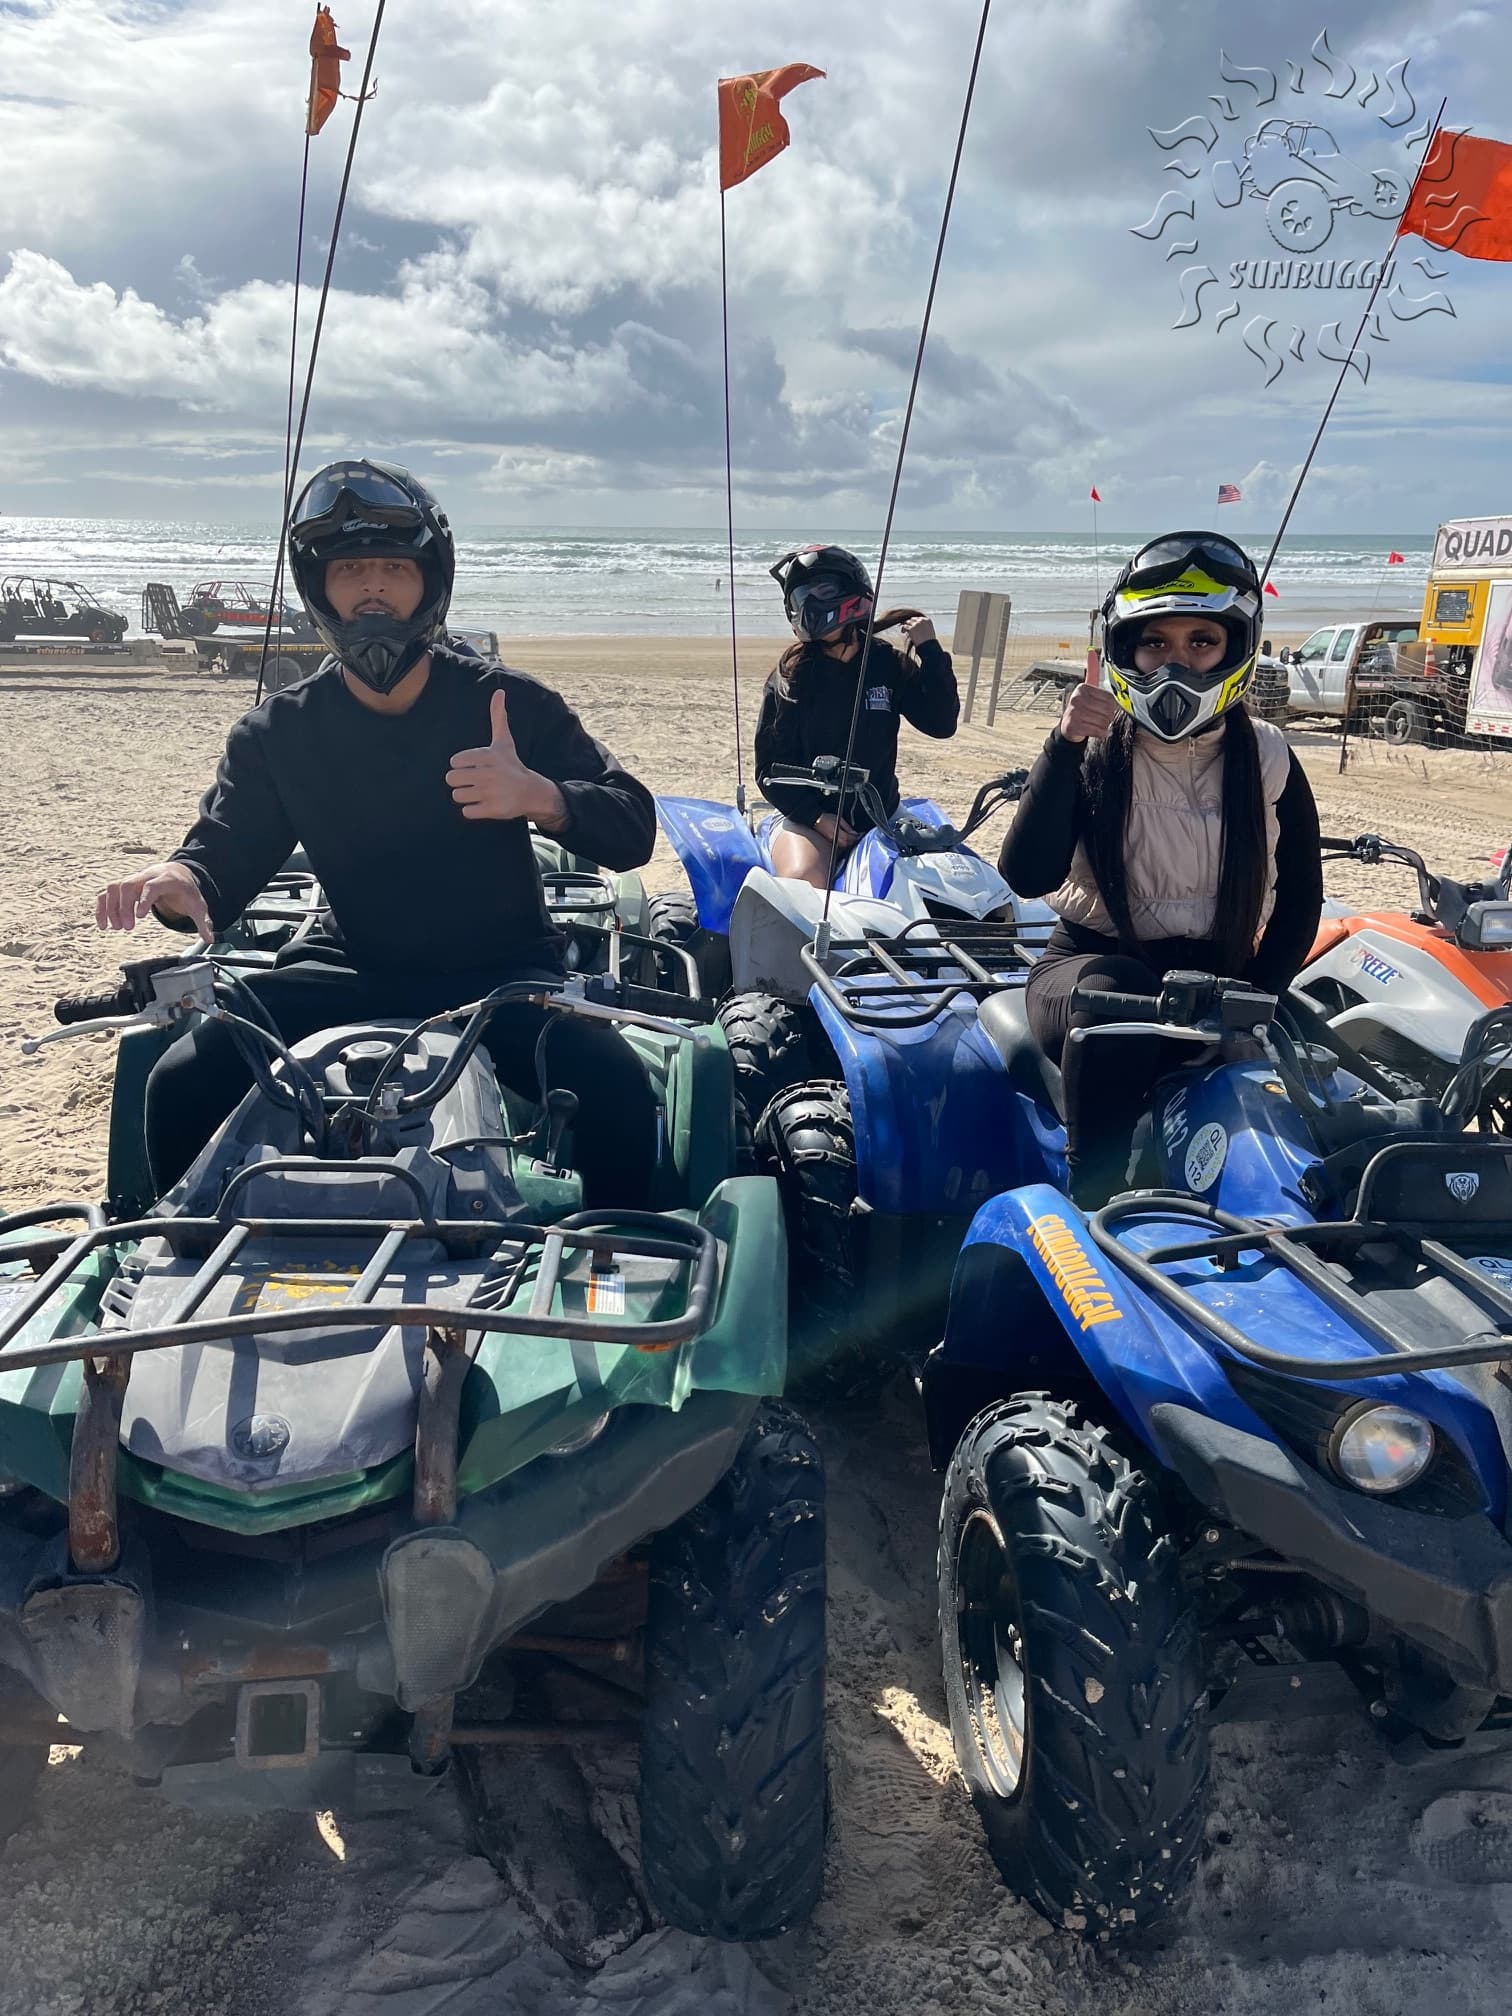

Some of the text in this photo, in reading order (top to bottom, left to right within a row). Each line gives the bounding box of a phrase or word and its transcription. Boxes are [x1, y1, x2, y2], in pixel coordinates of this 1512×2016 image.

[1445, 528, 1512, 561] QUAD
[1210, 1129, 1223, 1152] QL
[1188, 1160, 1202, 1186] 112
